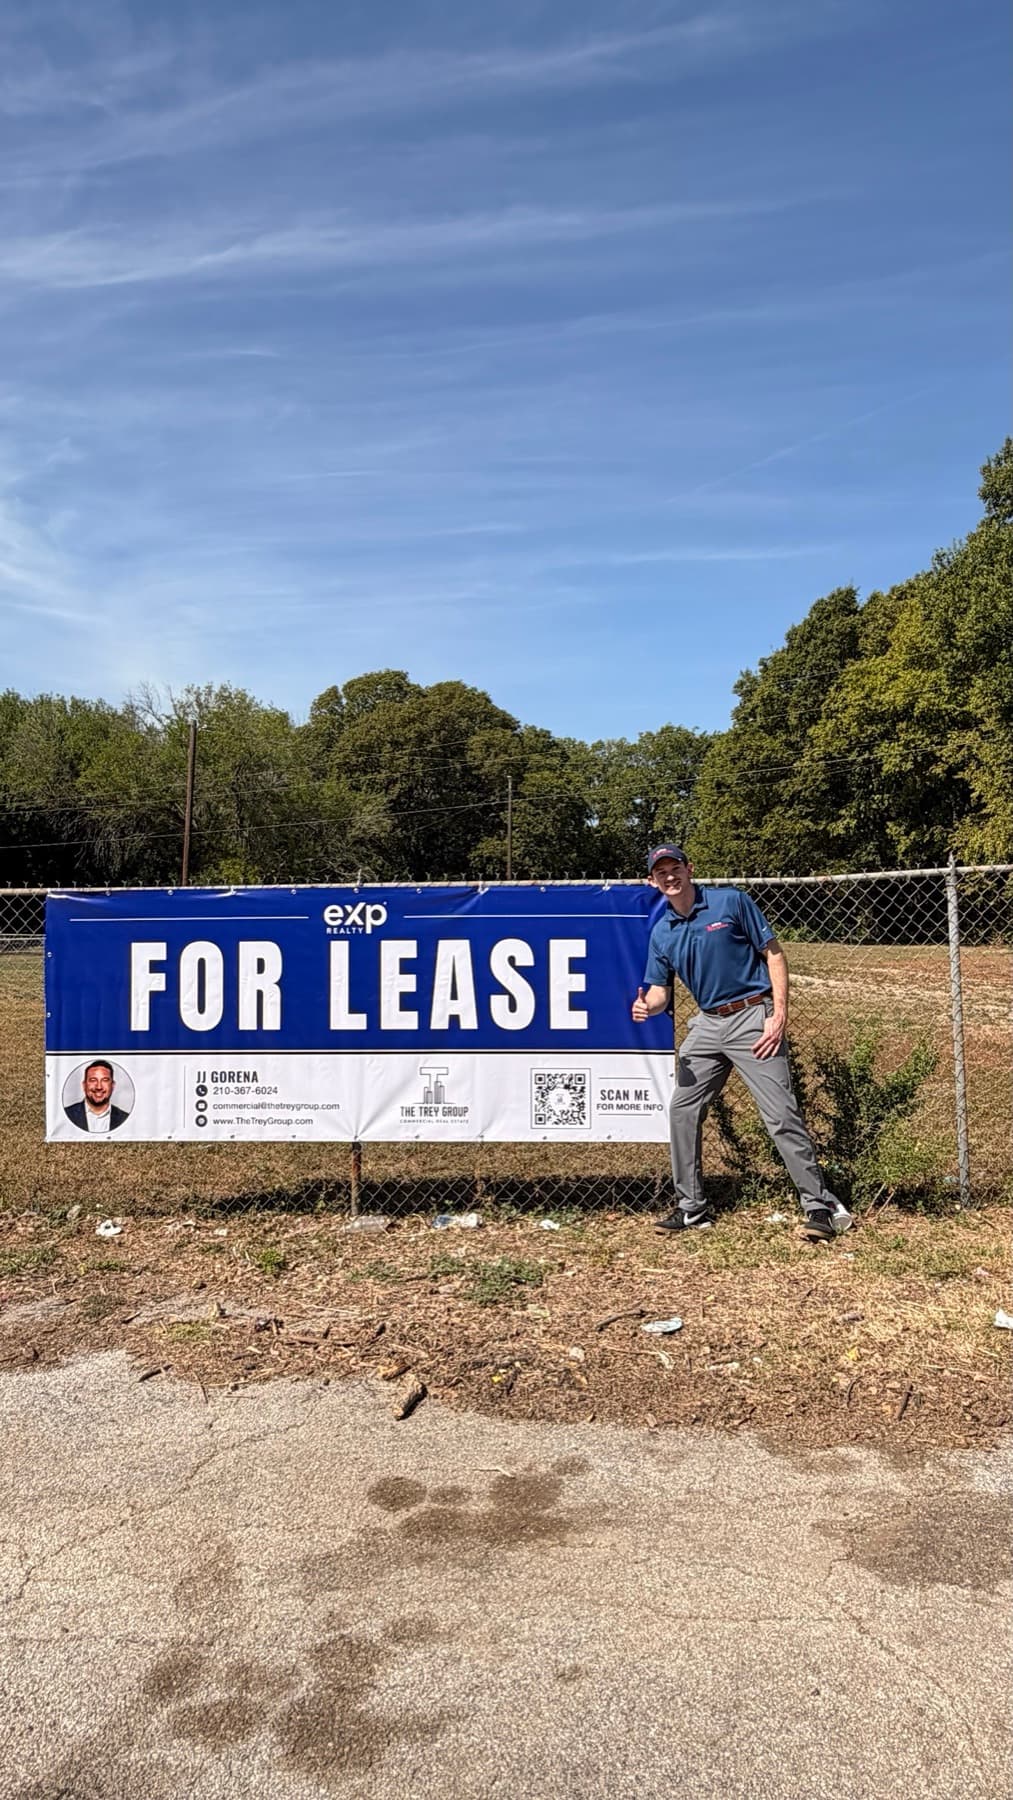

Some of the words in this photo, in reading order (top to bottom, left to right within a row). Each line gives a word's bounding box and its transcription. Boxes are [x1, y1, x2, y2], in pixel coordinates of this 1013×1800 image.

[130, 941, 283, 1031] FOR
[329, 938, 589, 1031] LEASE
[196, 1071, 206, 1083] JJ
[211, 1071, 259, 1083] GORENA
[213, 1086, 278, 1095] 210-367-6024
[600, 1089, 630, 1101] SCAN
[634, 1089, 650, 1101] ME
[212, 1102, 340, 1111] commercial@thetreygroup.com
[400, 1106, 416, 1117] THE
[419, 1106, 440, 1117] TREY
[442, 1106, 469, 1117] GROUP
[616, 1103, 641, 1111] MORE
[213, 1117, 313, 1126] www.TheTreyGroup.com
